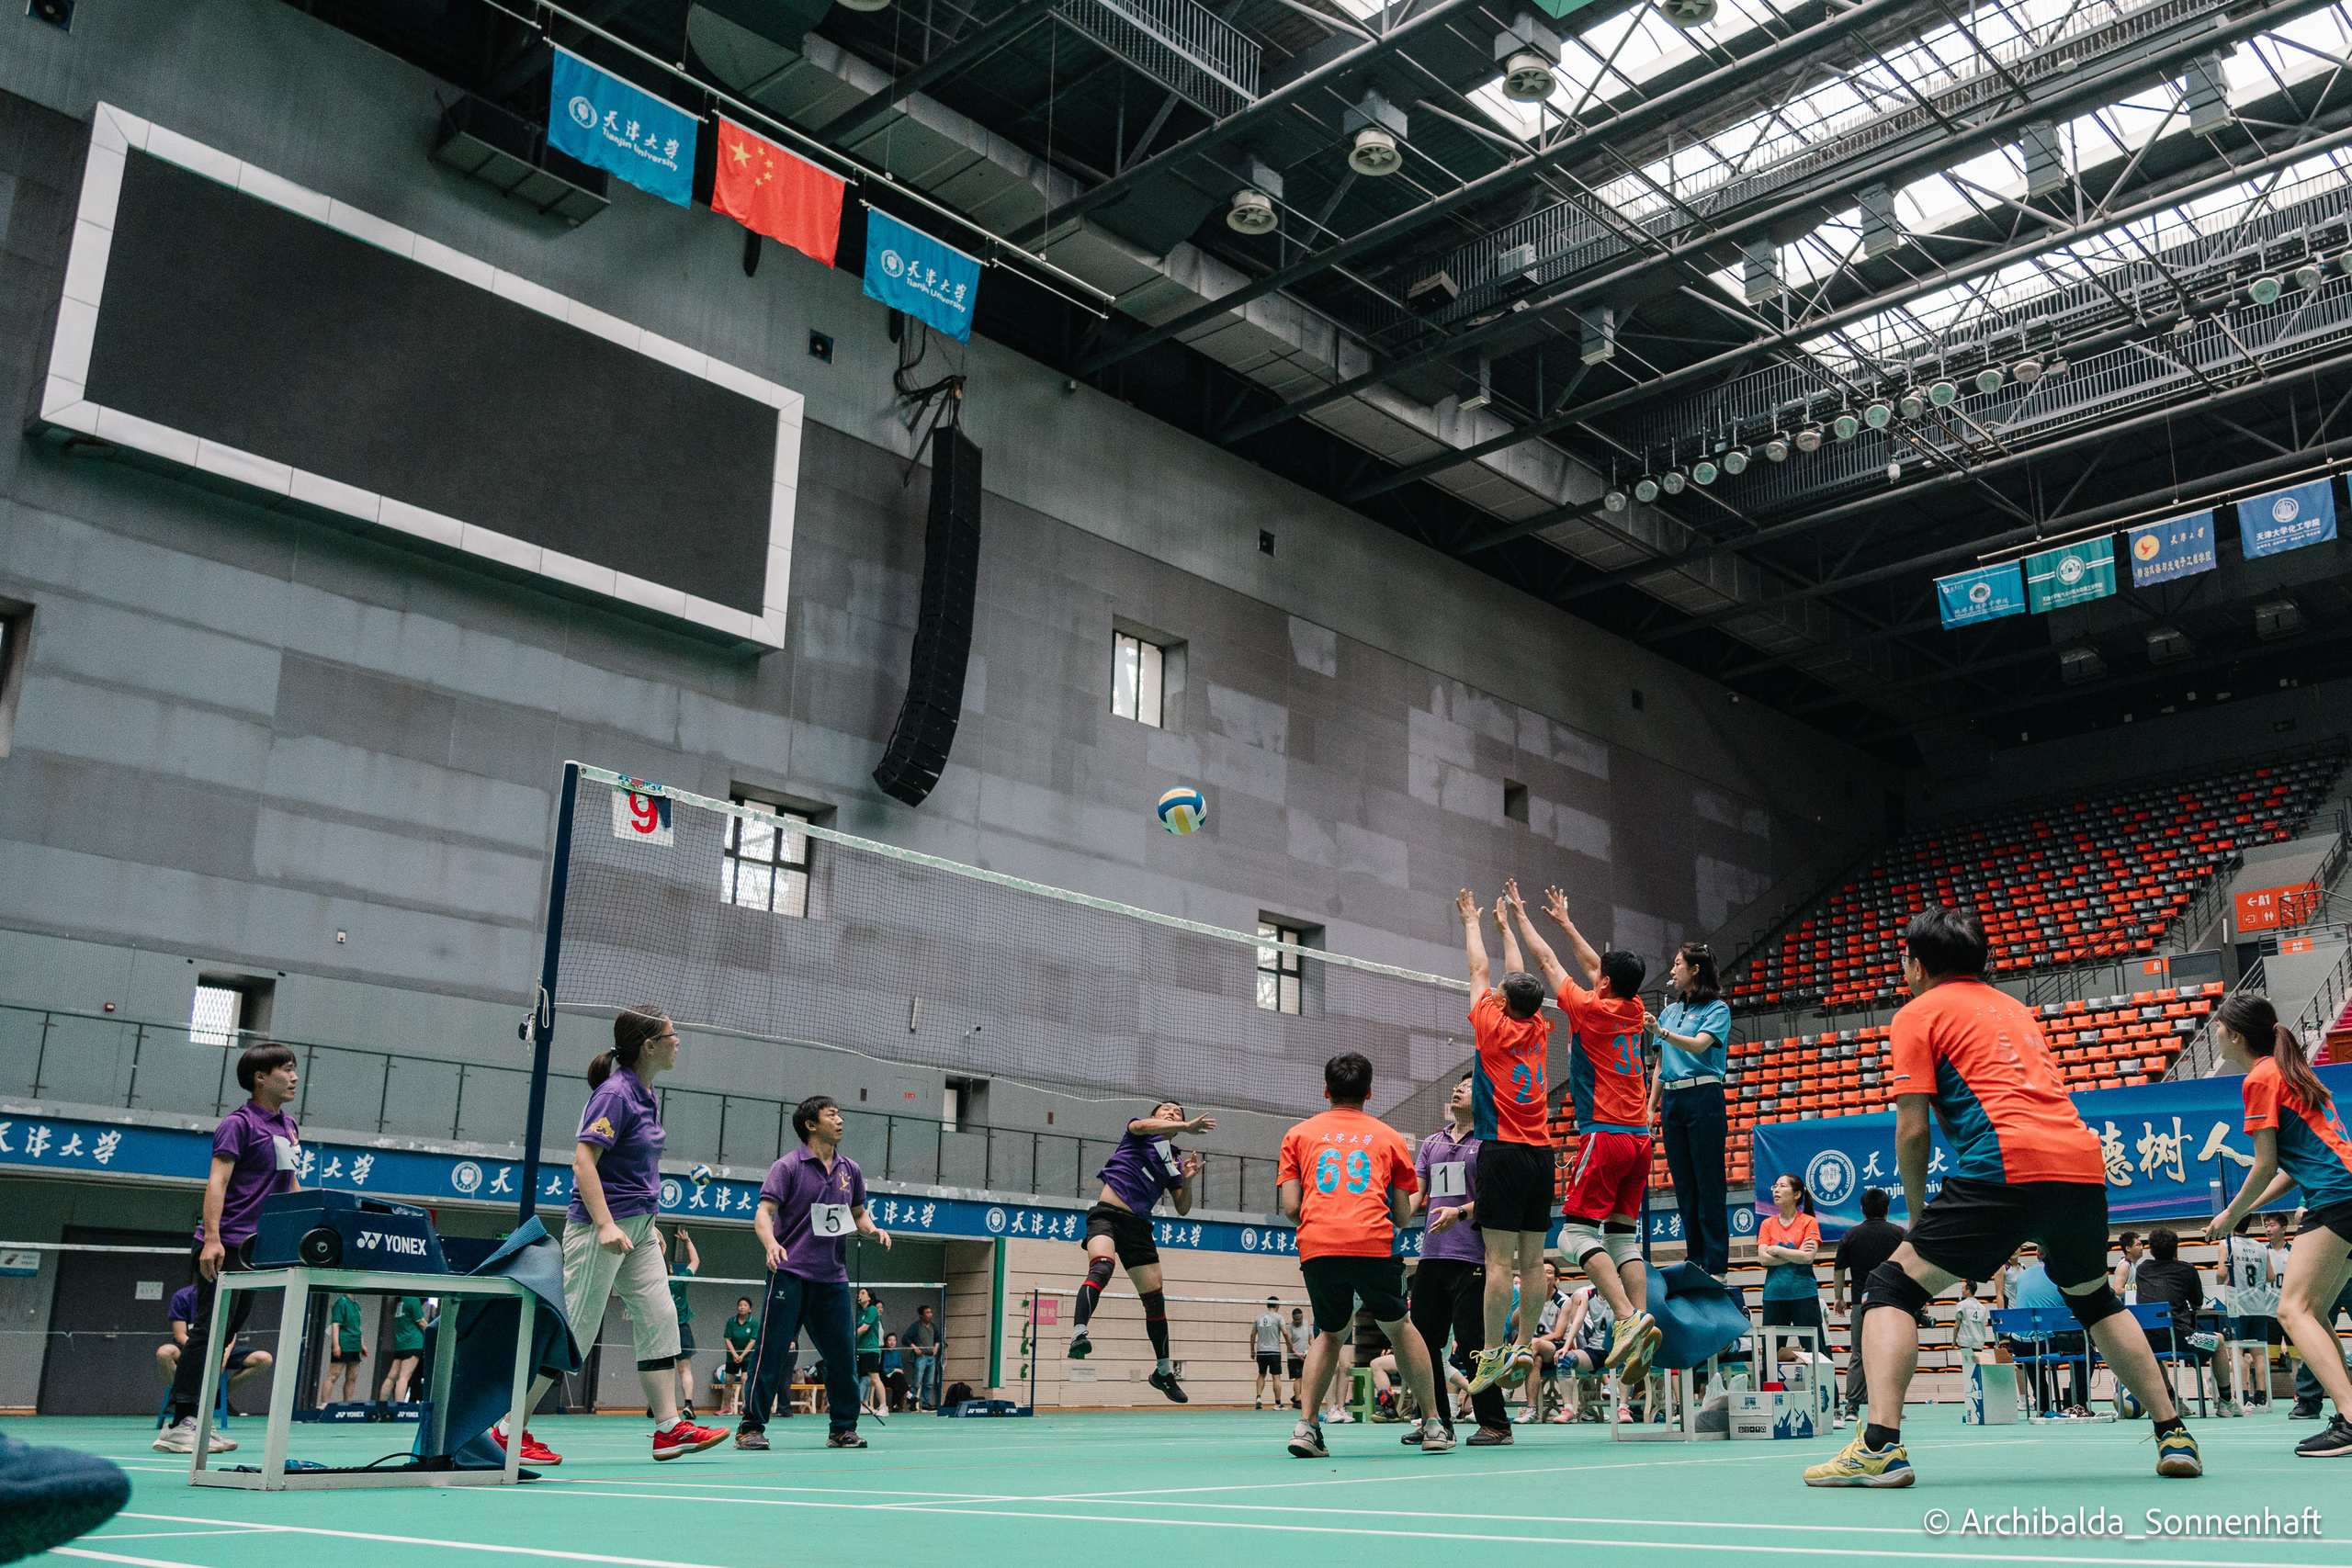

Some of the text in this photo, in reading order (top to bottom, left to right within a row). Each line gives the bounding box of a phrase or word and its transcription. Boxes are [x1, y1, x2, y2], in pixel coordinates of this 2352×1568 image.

[603, 110, 680, 160] 天津大学
[603, 127, 678, 172] Tianjin University
[907, 261, 967, 303] 天津大学
[2256, 518, 2321, 542] 天津大学化工学院
[629, 791, 658, 834] 9
[2258, 894, 2270, 906] A1
[2292, 942, 2303, 952] A2
[0, 1122, 122, 1165] 天津大学
[1321, 1133, 1374, 1145] 天津大学
[2088, 1116, 2256, 1186] 德树人
[295, 1149, 375, 1185] 津大学
[1316, 1148, 1372, 1195] 69
[1439, 1165, 1448, 1193] 1
[688, 1185, 762, 1213] 天津大
[825, 1207, 842, 1234] 5
[865, 1198, 936, 1229] 天津大学
[1012, 1211, 1078, 1239] 天津大学
[384, 1234, 427, 1256] YONEX
[1261, 1231, 1299, 1253] 天津大
[2245, 1264, 2256, 1288] 8
[1973, 1311, 1979, 1320] 4
